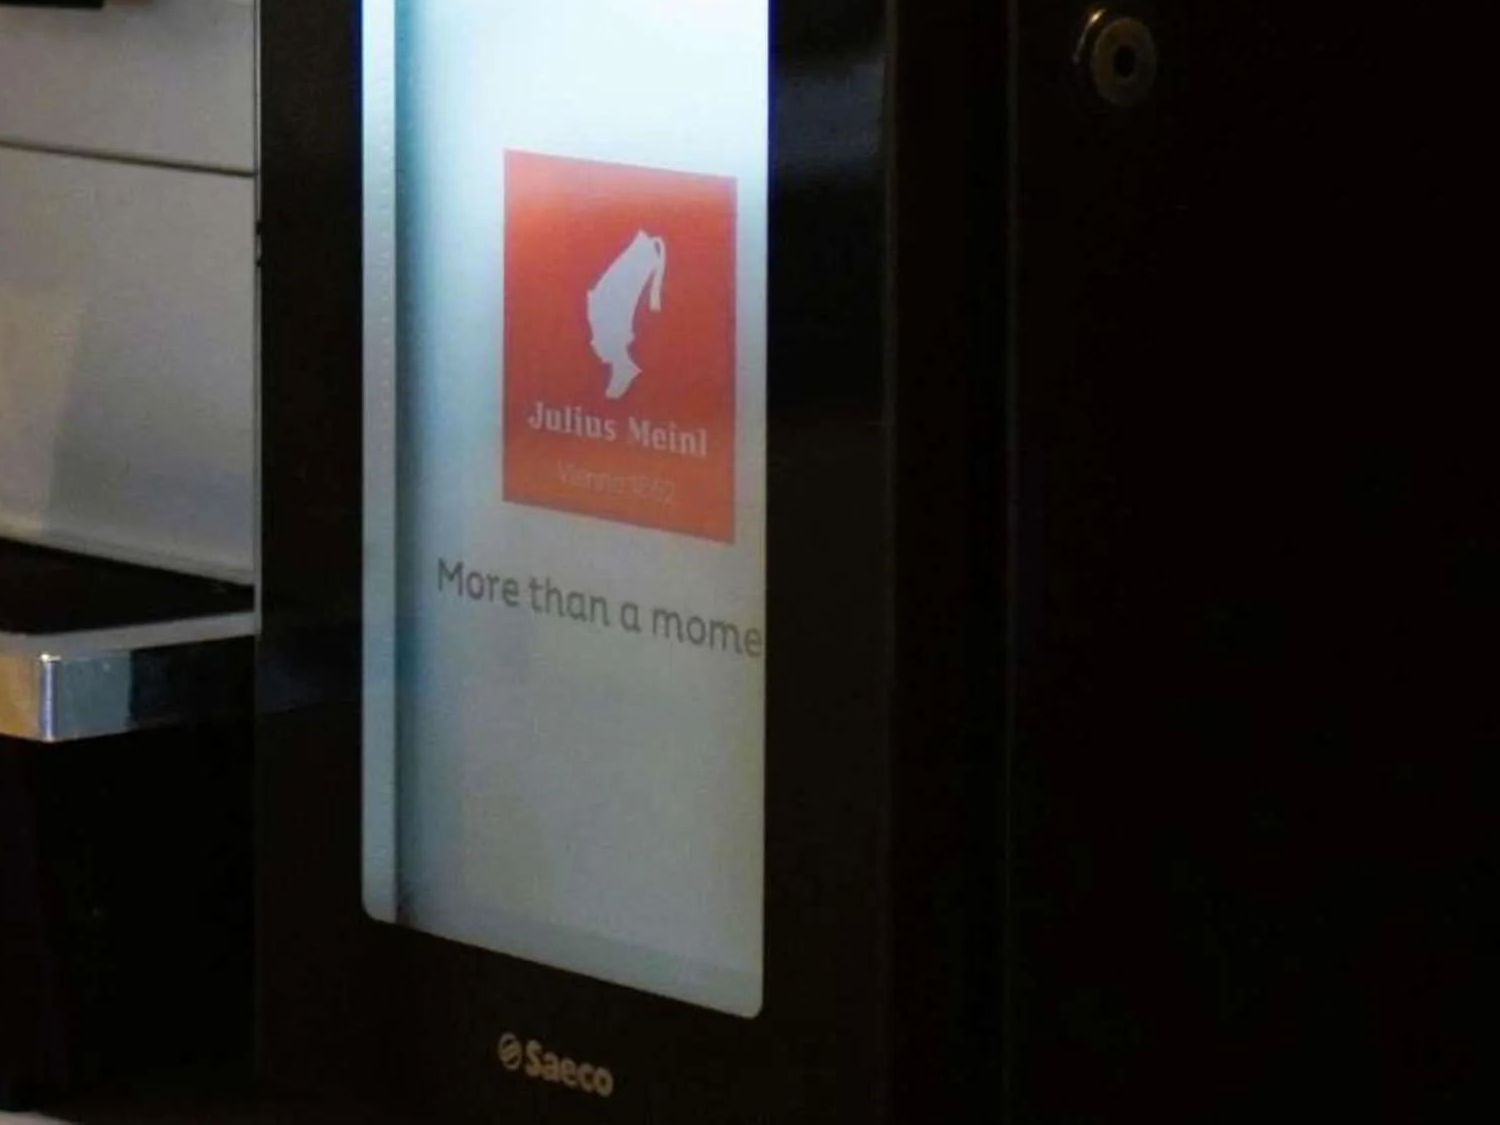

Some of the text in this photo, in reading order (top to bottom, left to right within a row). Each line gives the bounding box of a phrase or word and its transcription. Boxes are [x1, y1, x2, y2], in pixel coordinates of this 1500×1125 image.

[527, 401, 708, 458] Julius Meinl
[436, 557, 762, 658] More than a mome
[525, 1040, 614, 1097] Saeco
